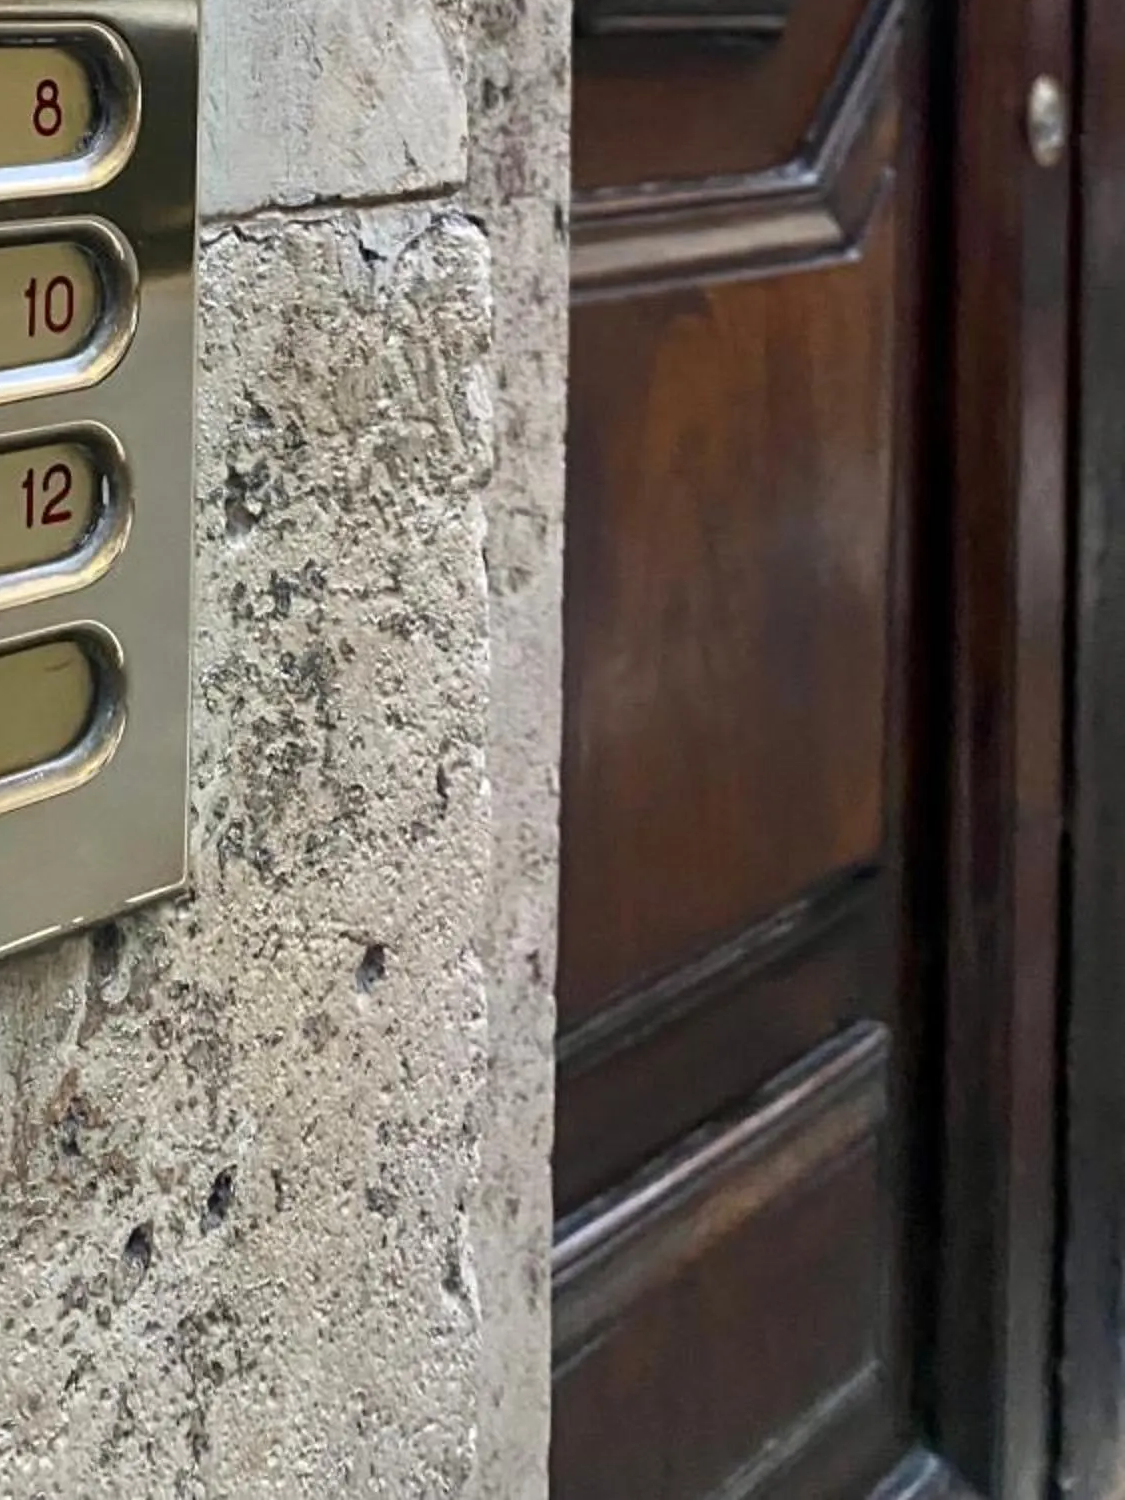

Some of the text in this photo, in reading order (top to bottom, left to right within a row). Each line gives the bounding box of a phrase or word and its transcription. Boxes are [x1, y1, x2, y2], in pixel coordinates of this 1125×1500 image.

[32, 79, 62, 137] 8
[25, 275, 74, 337] 10
[23, 463, 72, 529] 12
